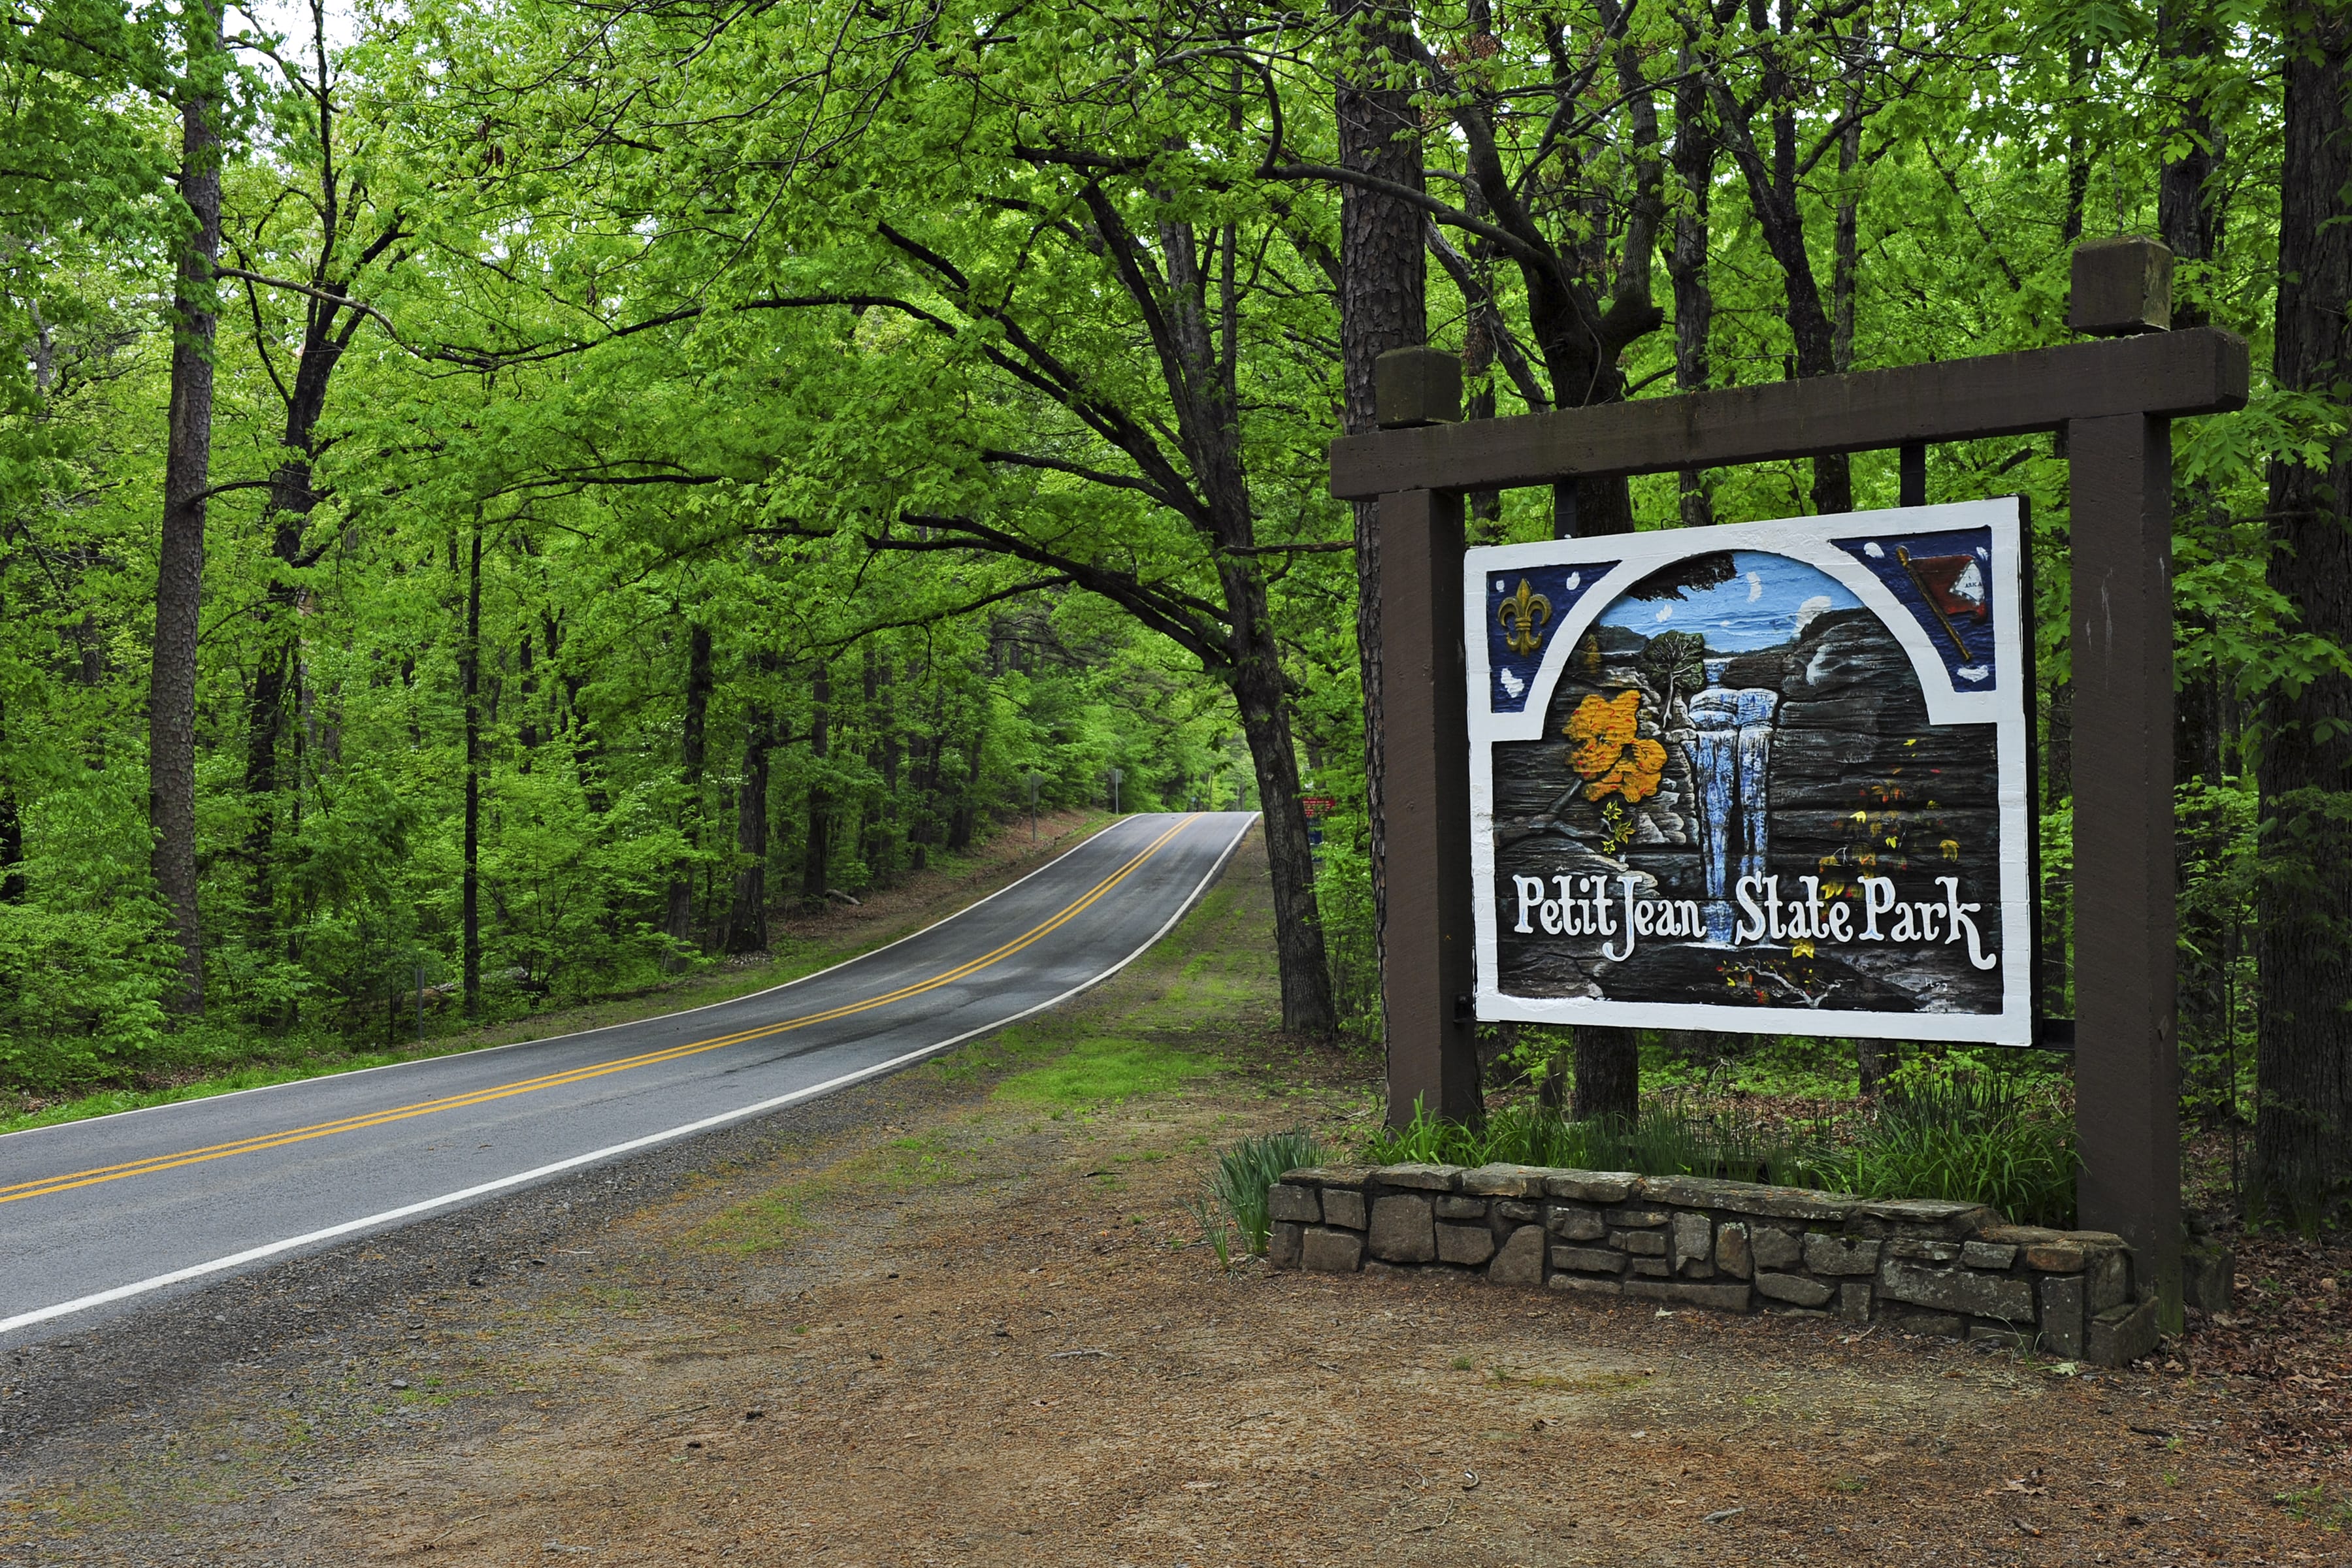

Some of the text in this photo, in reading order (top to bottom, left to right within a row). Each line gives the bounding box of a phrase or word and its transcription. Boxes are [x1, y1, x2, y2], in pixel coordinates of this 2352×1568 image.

[1511, 870, 1997, 971] Petit Jean State Park
